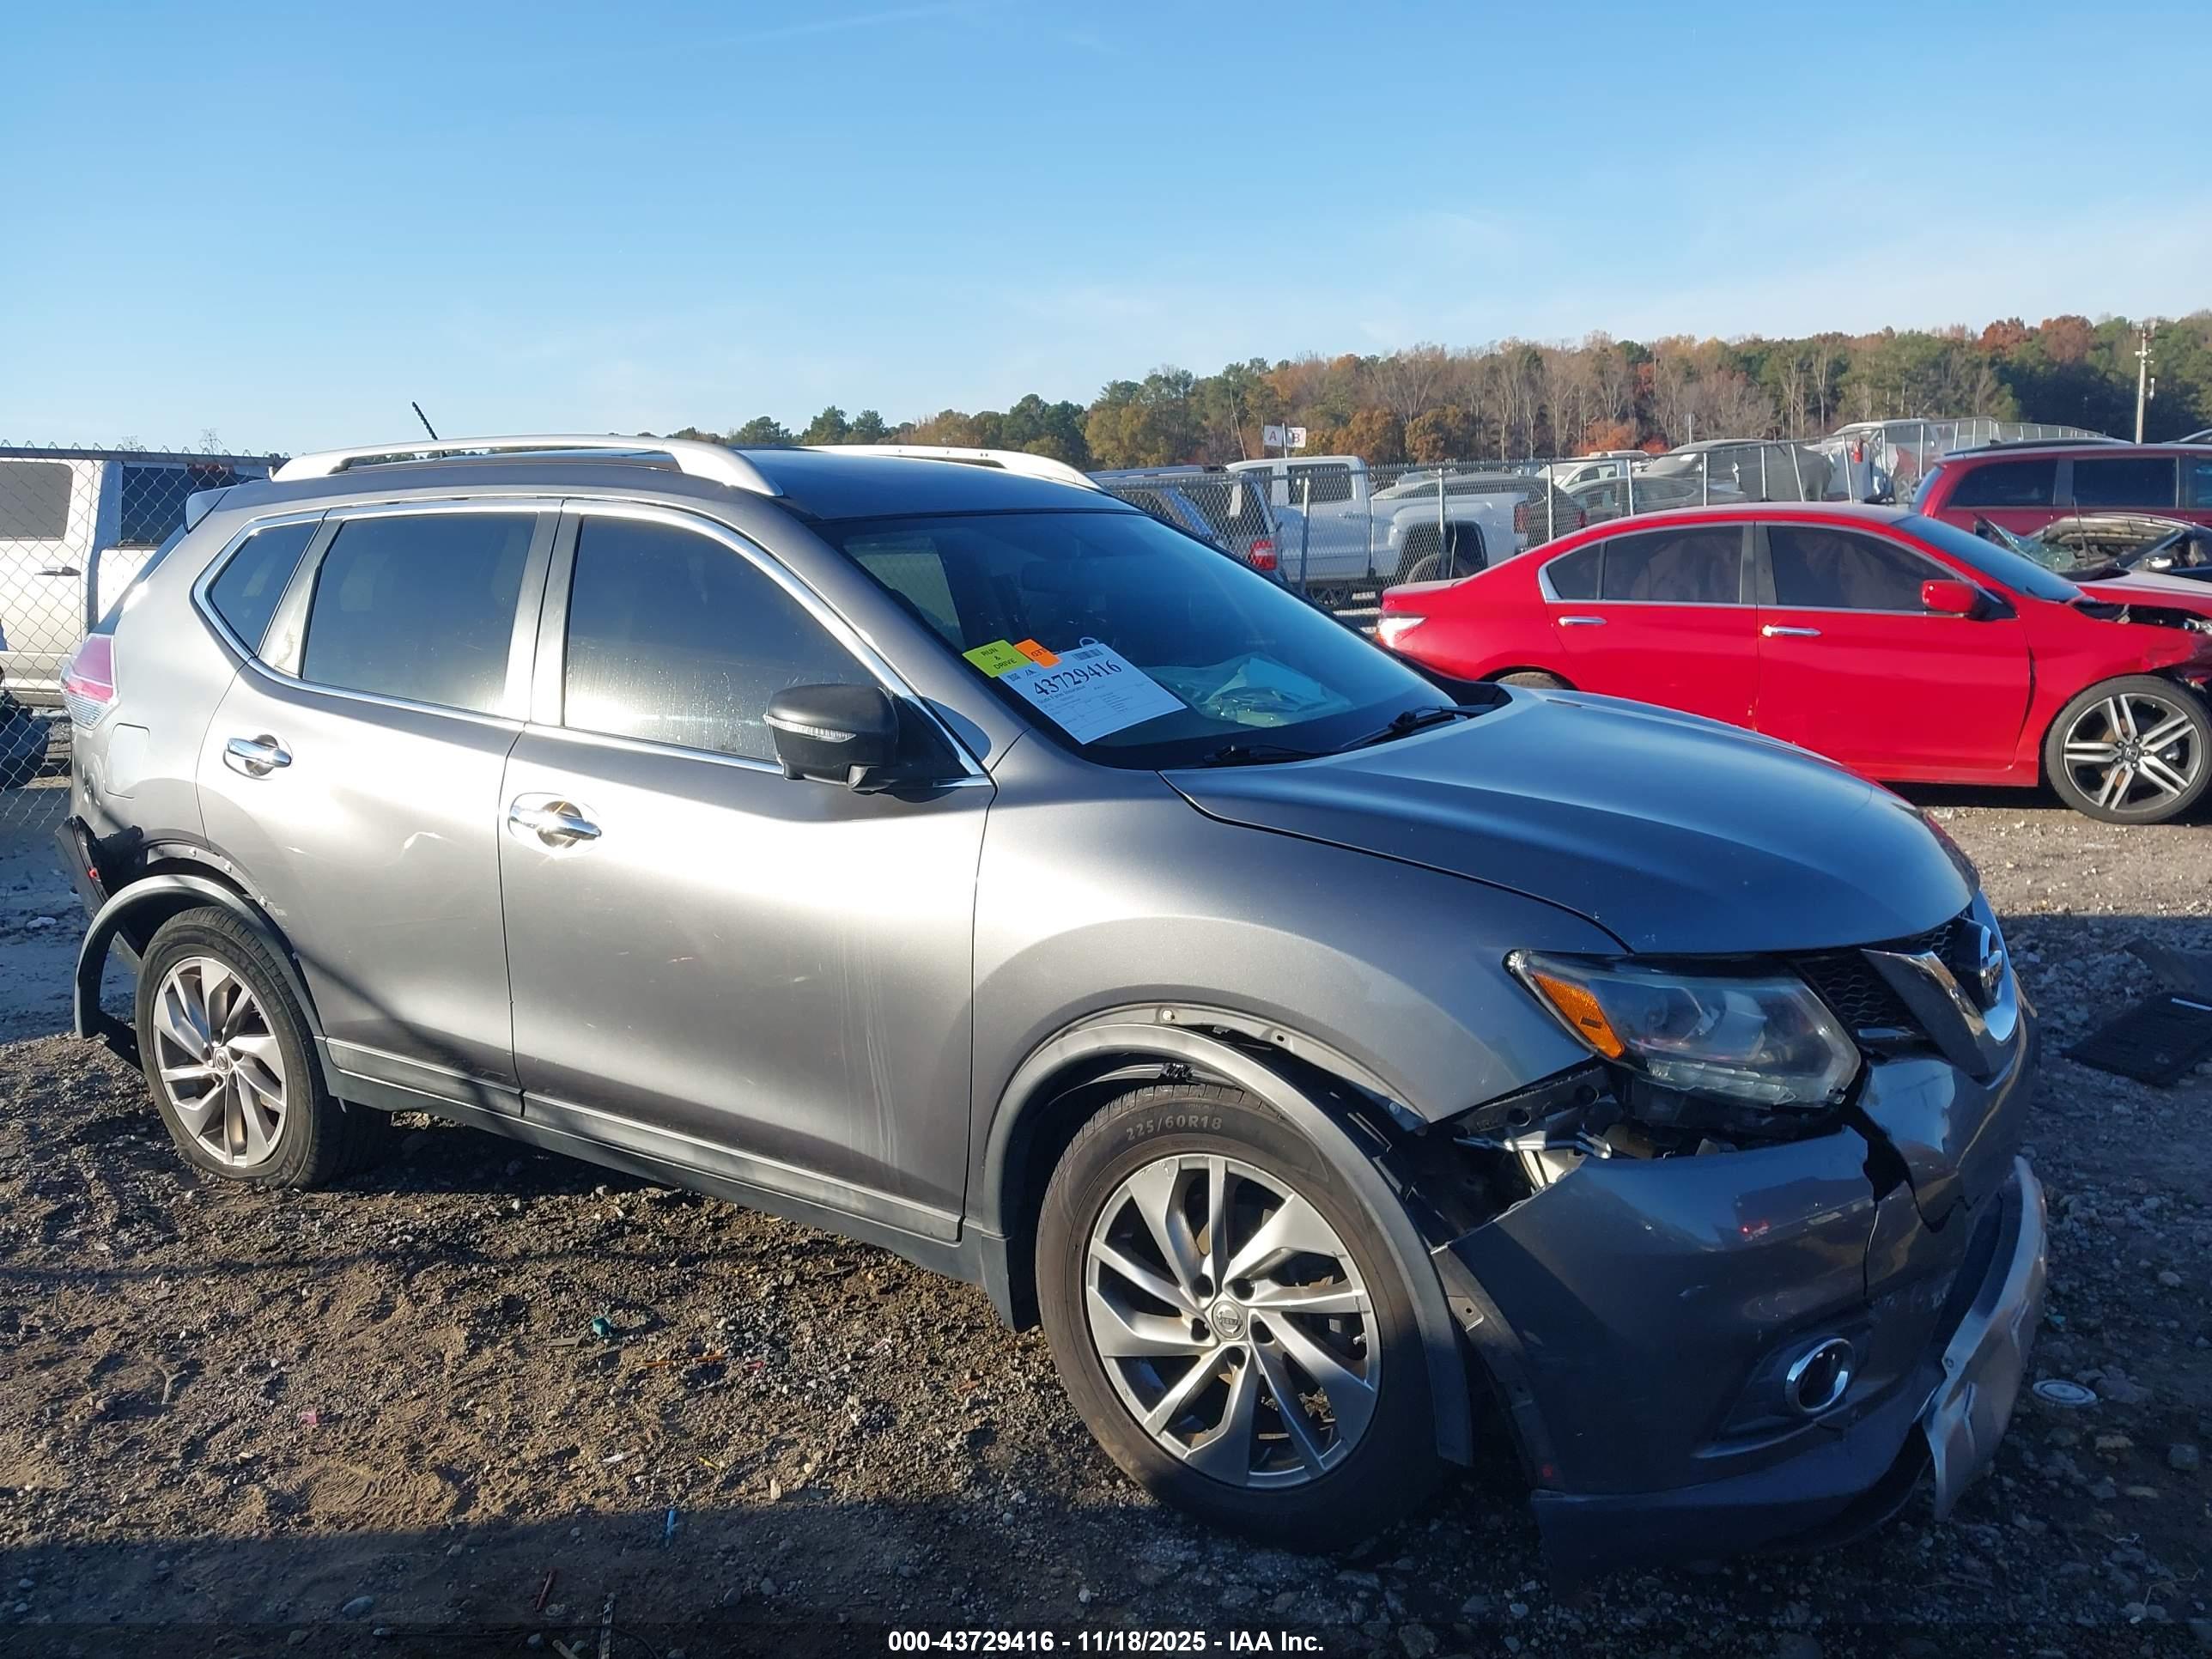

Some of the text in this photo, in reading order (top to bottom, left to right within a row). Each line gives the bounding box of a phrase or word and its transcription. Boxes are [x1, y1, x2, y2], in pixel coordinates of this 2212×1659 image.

[1268, 430, 1278, 441] A
[1291, 432, 1300, 444] B
[980, 647, 999, 657] RUN
[993, 658, 1018, 670] DRIVE
[1034, 659, 1122, 696] 43729416
[1126, 1115, 1223, 1141] 225/60R18
